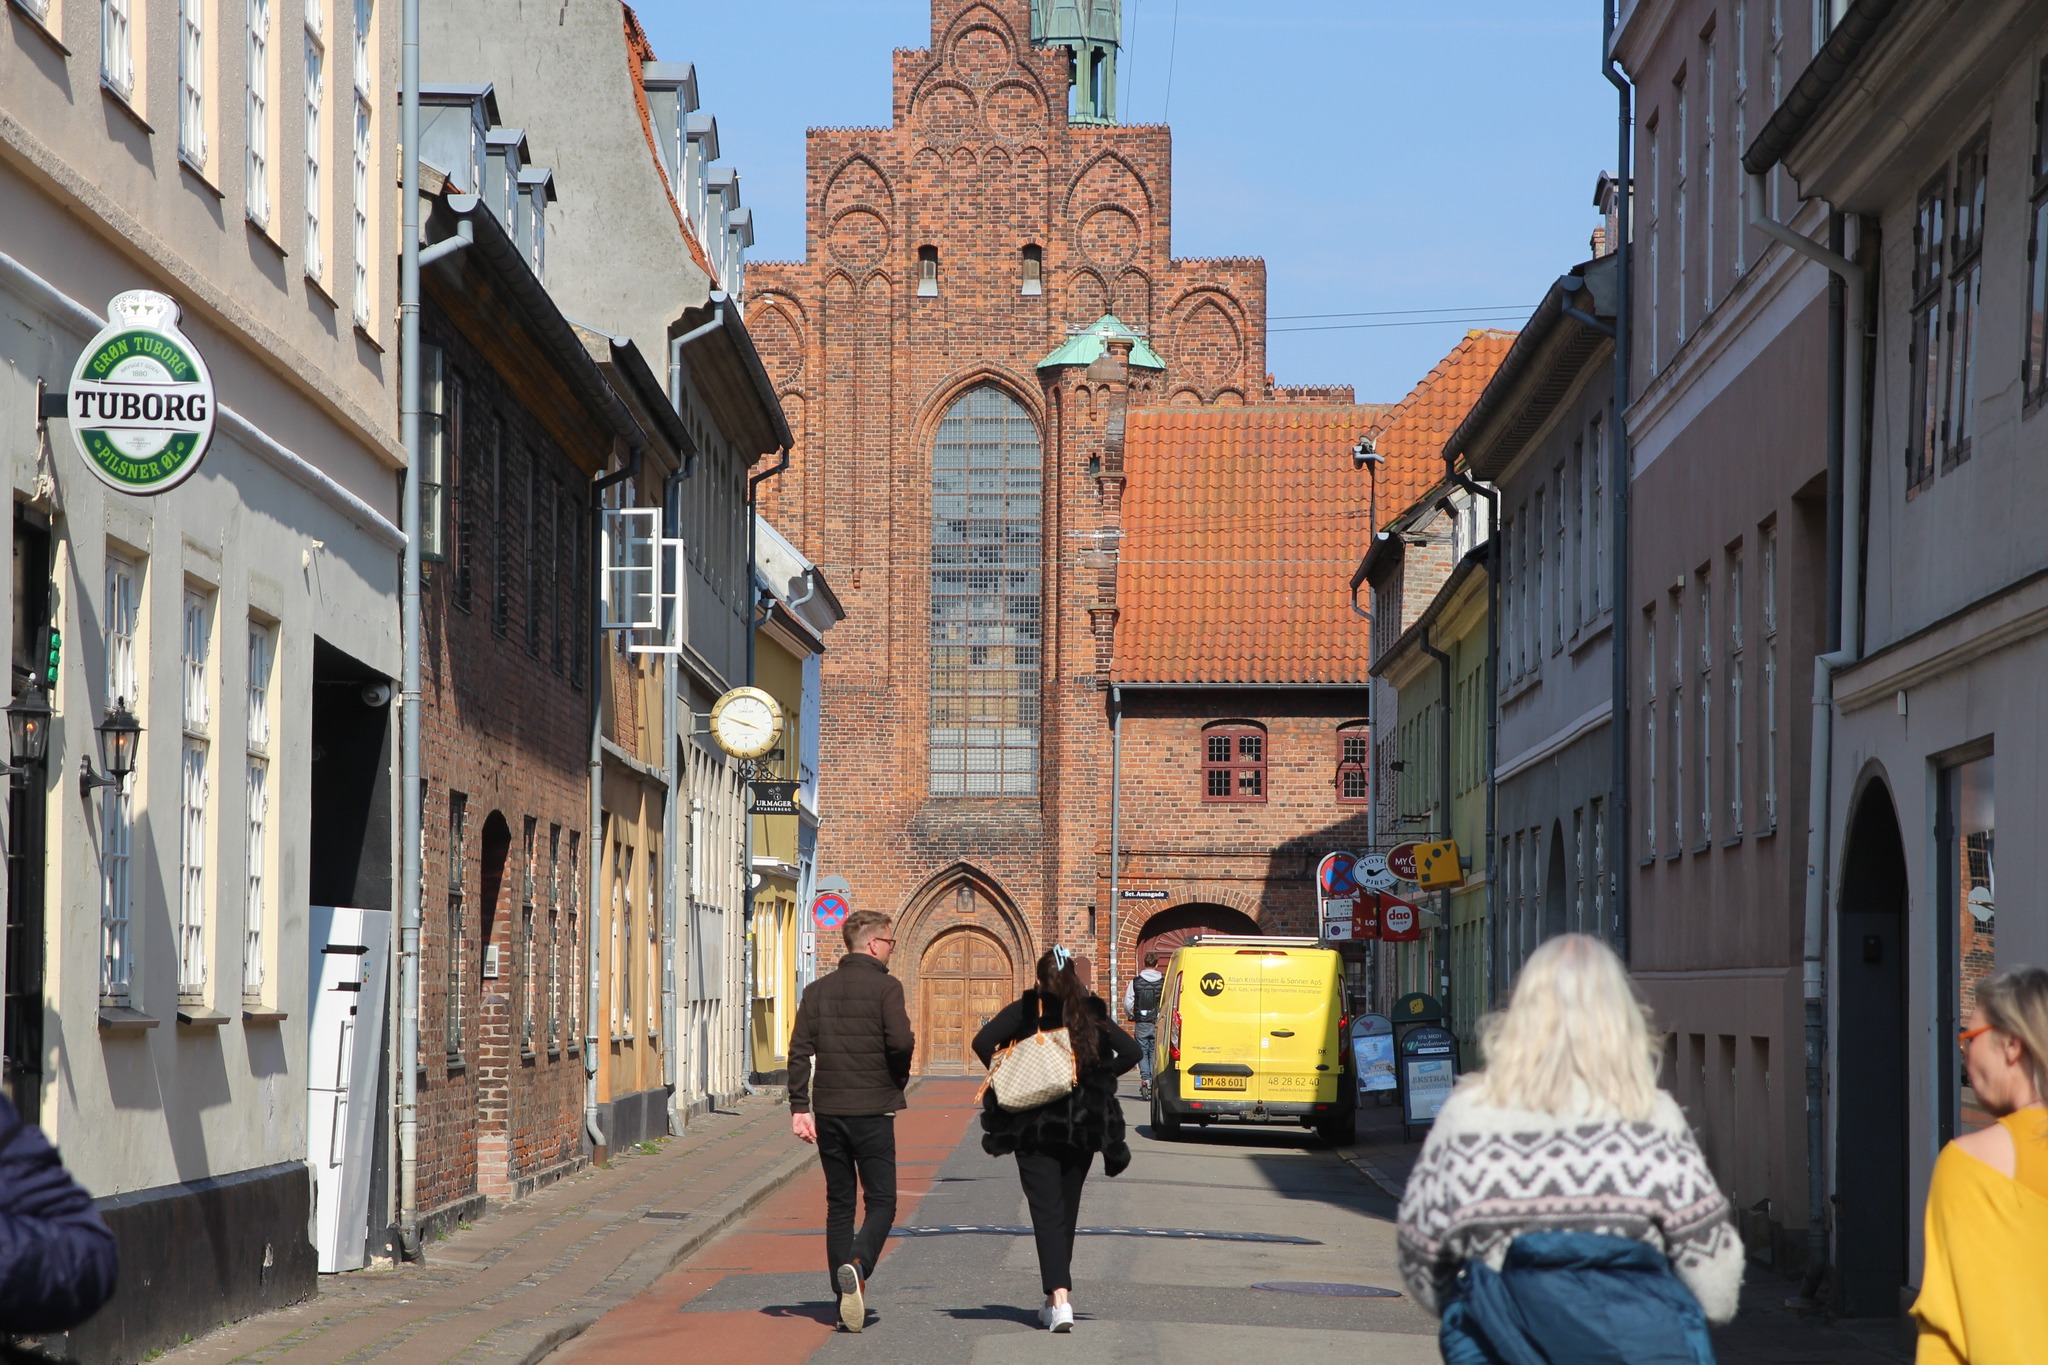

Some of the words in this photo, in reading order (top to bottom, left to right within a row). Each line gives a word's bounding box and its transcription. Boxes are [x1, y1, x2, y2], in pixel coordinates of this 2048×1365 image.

[93, 339, 129, 374] GRØN
[134, 336, 188, 375] TUBORG
[75, 390, 206, 422] TUBORG
[97, 446, 161, 480] PILSNER
[161, 450, 182, 470] ØL
[1359, 858, 1384, 870] KLOST
[1395, 857, 1408, 866] MY
[1401, 866, 1416, 874] BLE
[1365, 878, 1390, 886] PIBEN
[1388, 909, 1410, 920] dao
[1201, 979, 1224, 990] VVS
[1201, 1077, 1214, 1086] DM
[1215, 1078, 1227, 1087] 48
[1228, 1078, 1244, 1087] 601
[1268, 1077, 1279, 1086] 48
[1281, 1077, 1293, 1086] 28
[1295, 1077, 1306, 1086] 62
[1308, 1077, 1320, 1087] 40
[1412, 1074, 1449, 1084] EKSTRA!
